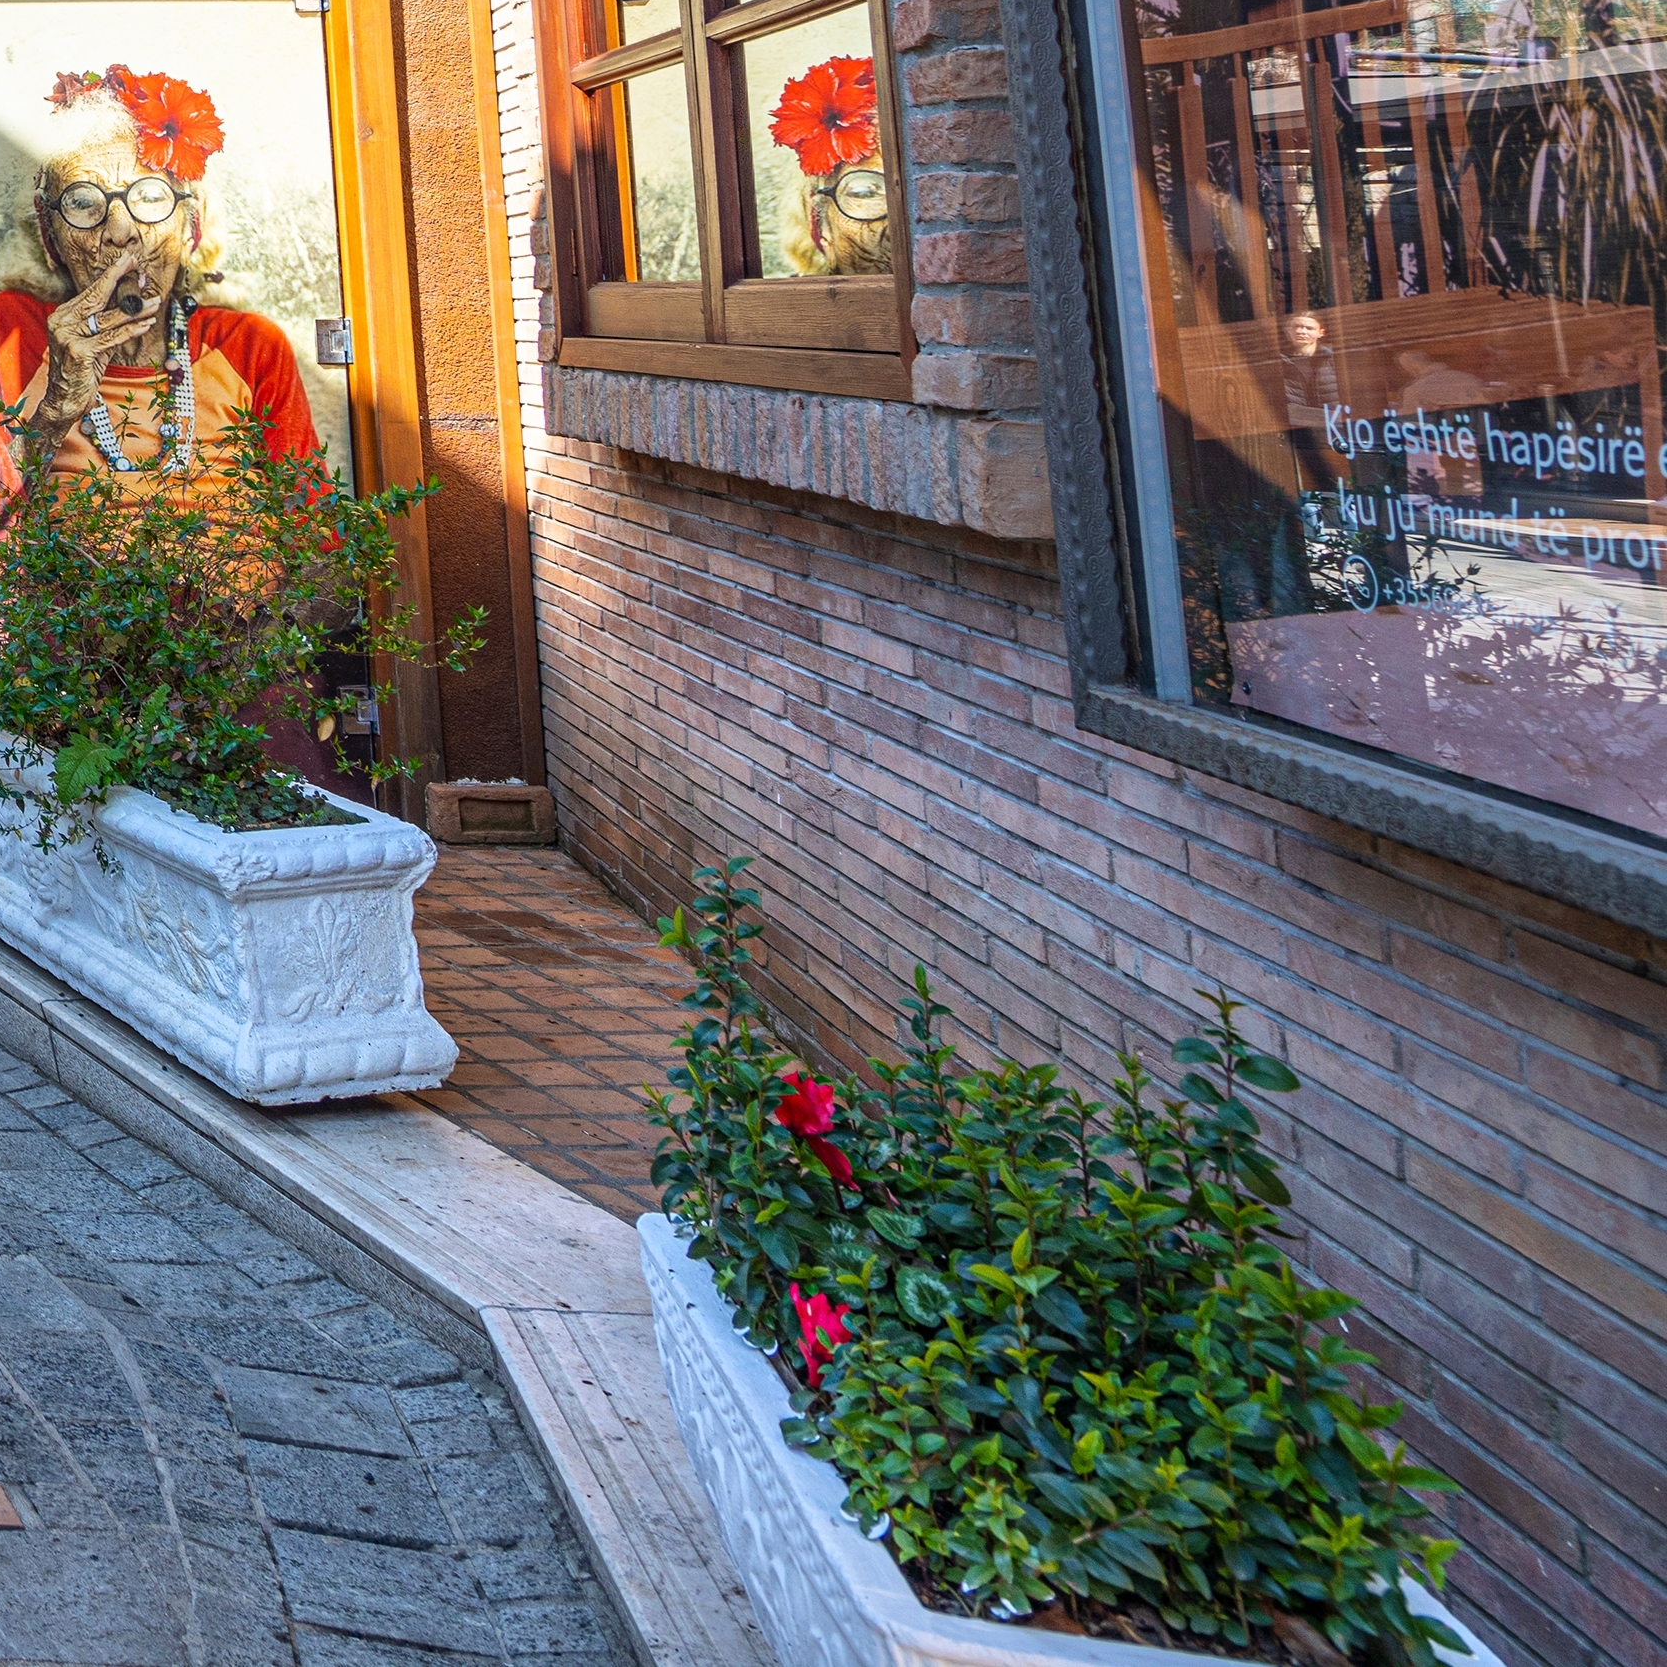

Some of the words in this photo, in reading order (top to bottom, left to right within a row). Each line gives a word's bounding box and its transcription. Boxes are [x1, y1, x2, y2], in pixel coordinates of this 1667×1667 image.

[1323, 403, 1374, 460] Kjo
[1383, 407, 1477, 460] është
[1483, 411, 1646, 480] hapësirë
[1337, 476, 1377, 527] ku
[1384, 485, 1416, 541] ju
[1427, 497, 1520, 548] mund
[1531, 507, 1571, 556] të
